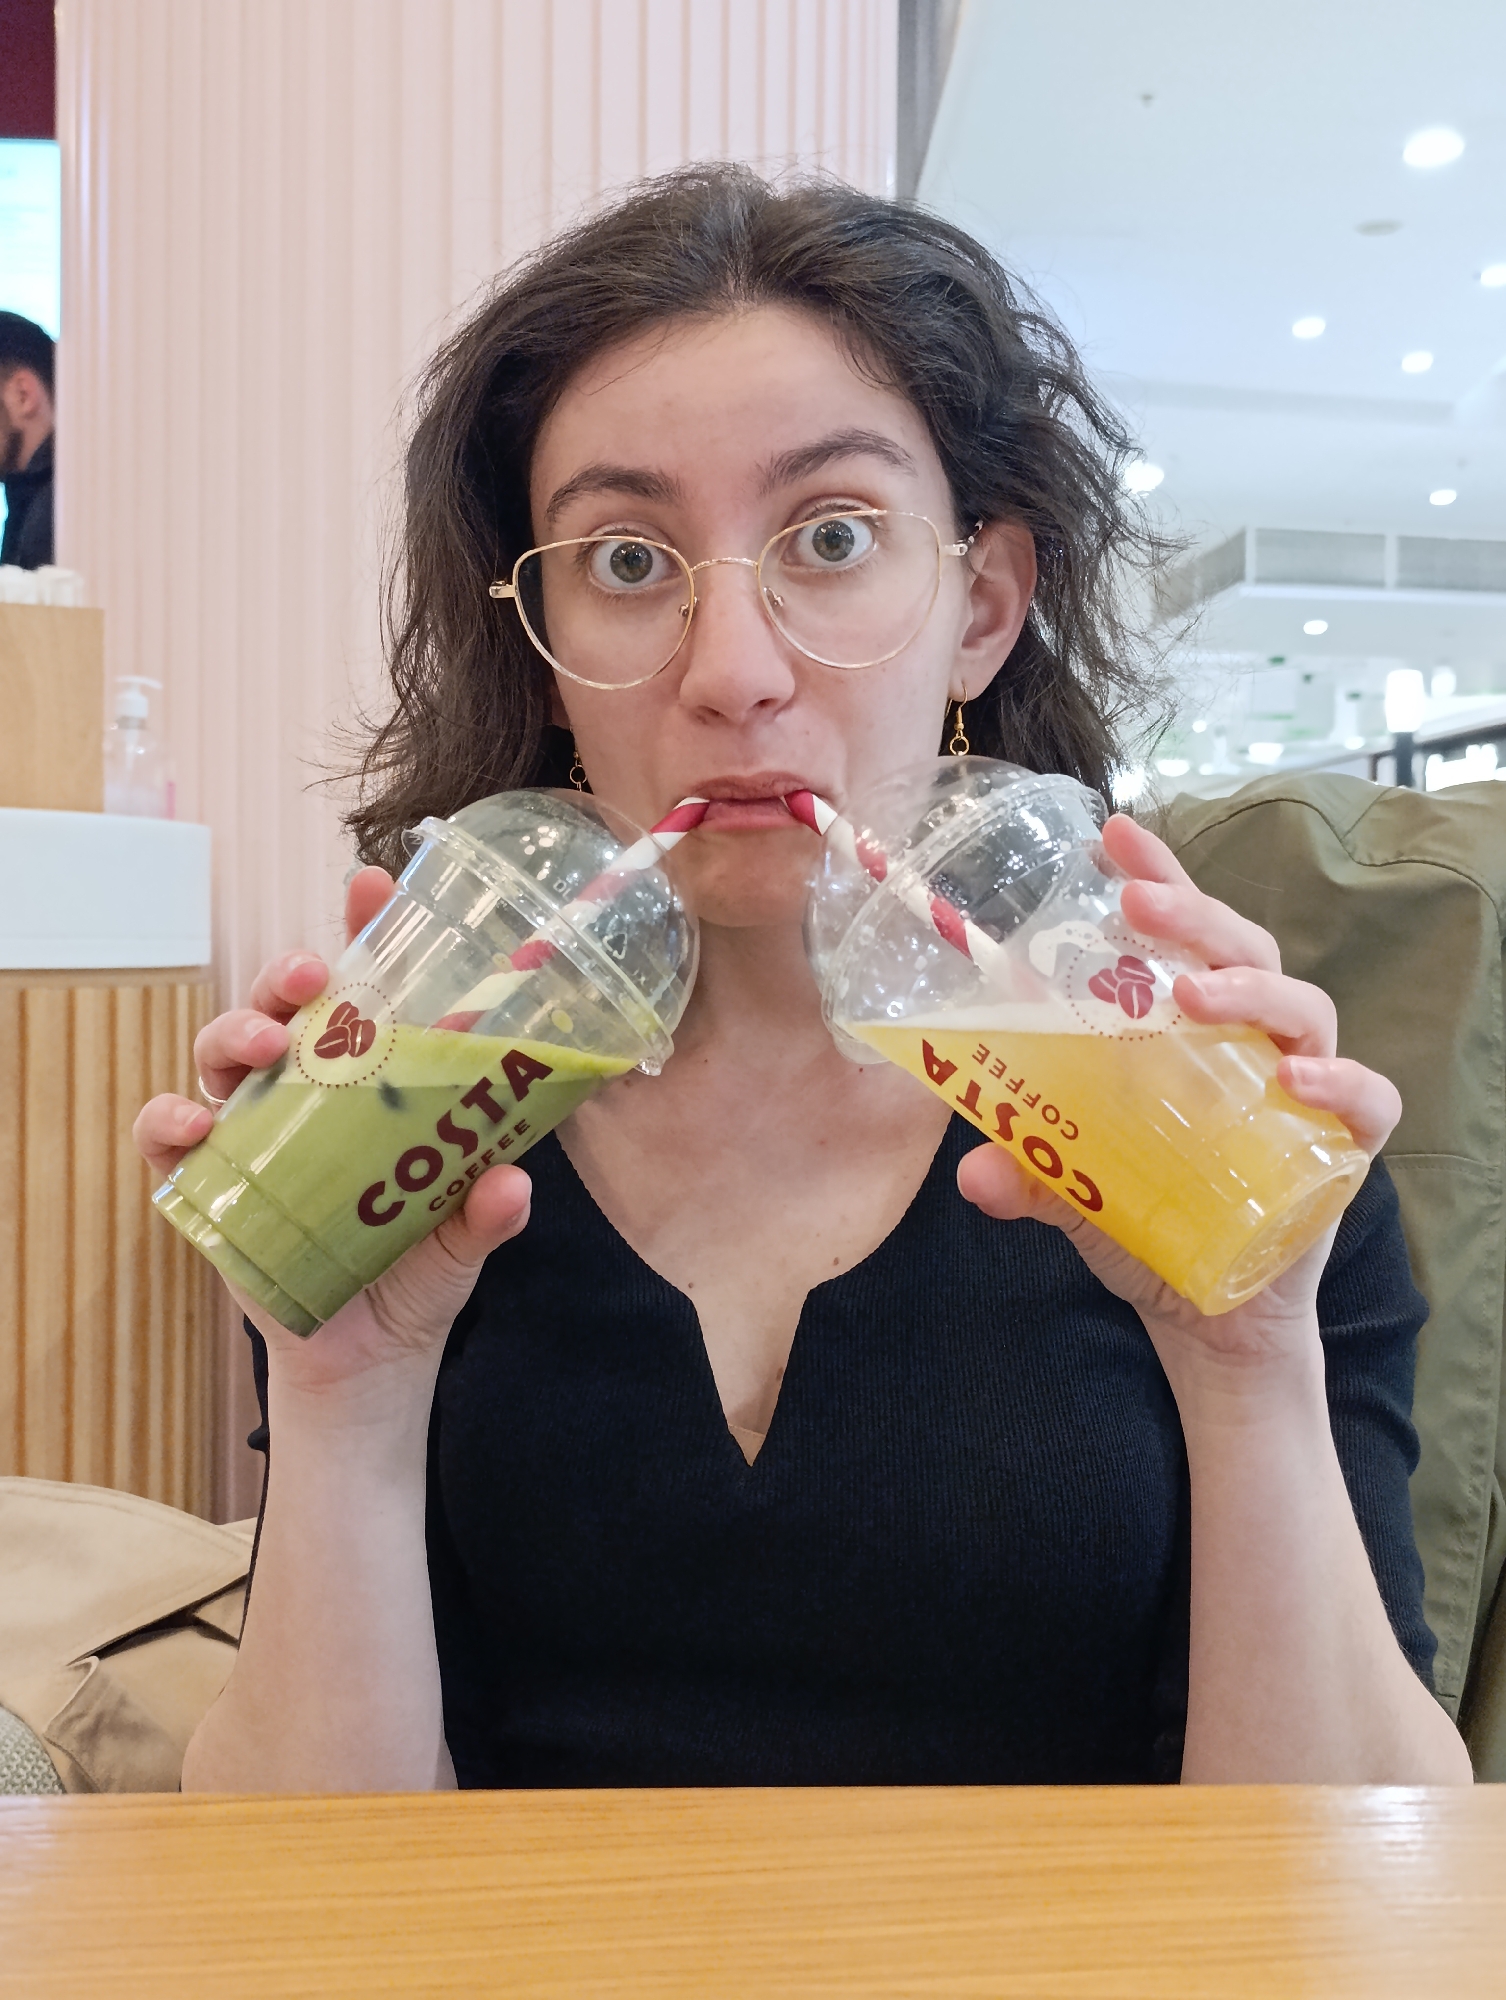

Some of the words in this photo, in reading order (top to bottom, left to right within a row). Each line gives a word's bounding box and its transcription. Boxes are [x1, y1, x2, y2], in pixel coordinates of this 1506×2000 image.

[358, 1049, 553, 1226] COSTA
[922, 1038, 1103, 1212] COSTA
[972, 1043, 1079, 1140] COFFEE
[429, 1119, 530, 1211] COFFEE
